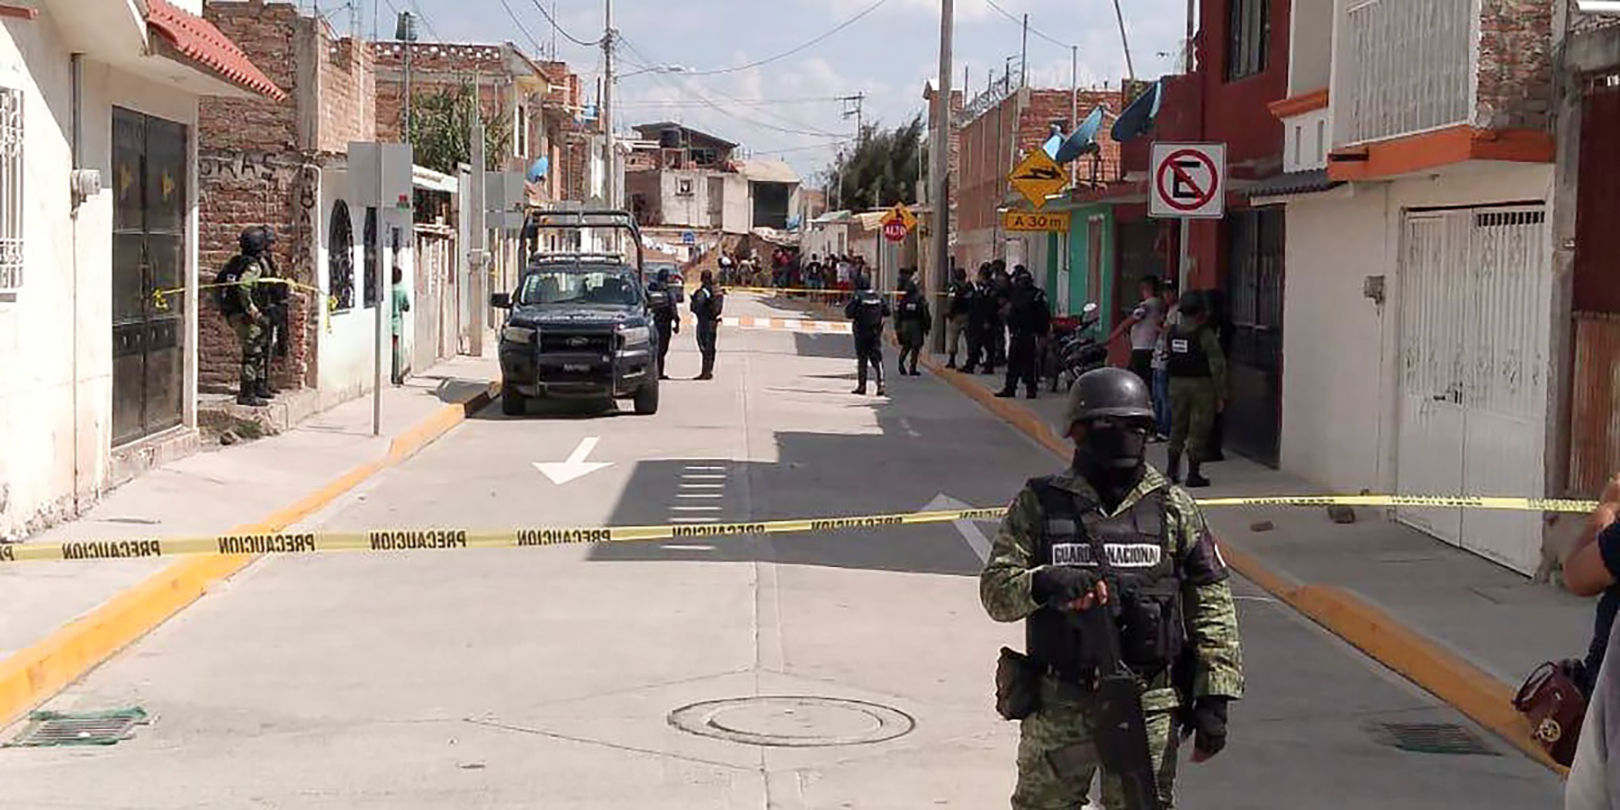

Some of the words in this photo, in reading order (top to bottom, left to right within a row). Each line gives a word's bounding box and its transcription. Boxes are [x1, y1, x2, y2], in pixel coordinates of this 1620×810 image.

[1173, 161, 1202, 198] E
[1014, 216, 1025, 227] A
[1027, 215, 1048, 227] 30
[884, 225, 906, 236] ALTO
